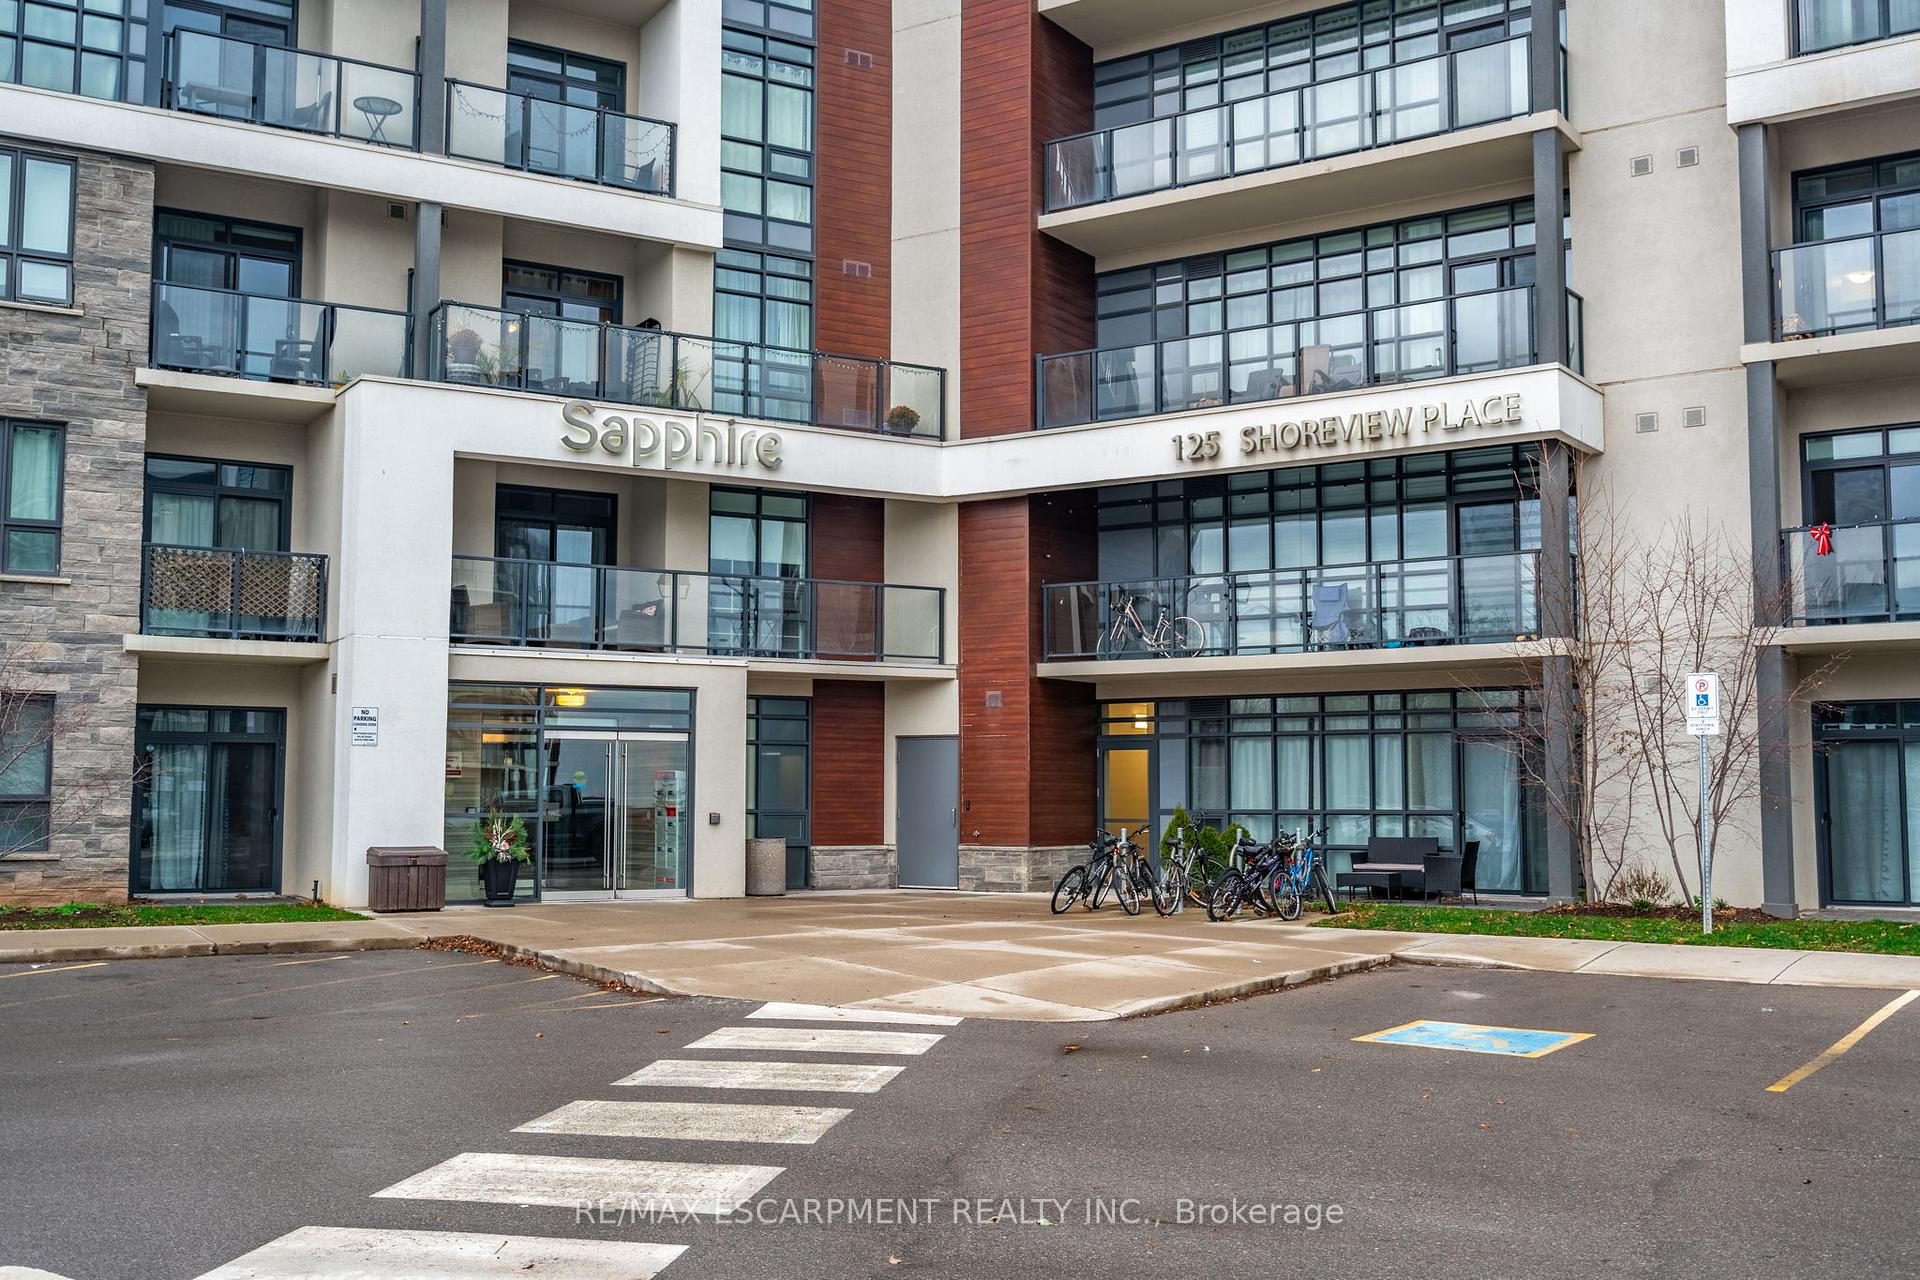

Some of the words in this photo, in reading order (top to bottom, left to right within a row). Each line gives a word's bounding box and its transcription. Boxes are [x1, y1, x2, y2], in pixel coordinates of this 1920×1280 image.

[561, 400, 783, 469] Sapphire
[1171, 430, 1221, 461] 125
[1239, 406, 1413, 454] SHOREVIEW
[1422, 393, 1522, 433] PLACE
